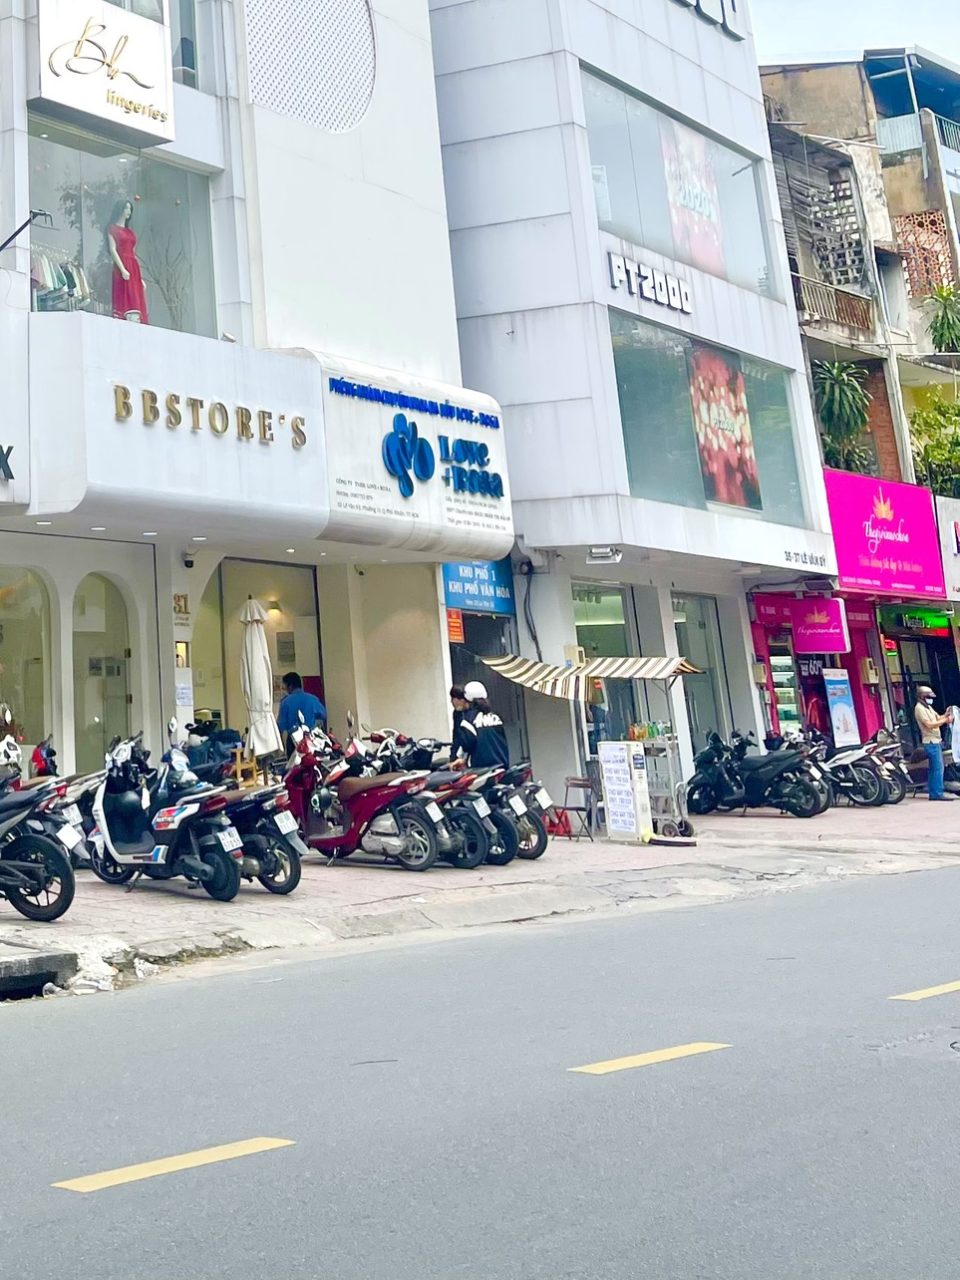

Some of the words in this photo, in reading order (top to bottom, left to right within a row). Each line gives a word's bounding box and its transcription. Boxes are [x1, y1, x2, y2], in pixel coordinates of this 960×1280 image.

[106, 88, 169, 123] lingeries
[607, 251, 693, 314] PT2000
[458, 565, 473, 578] KHU
[491, 570, 496, 581] 1
[448, 581, 463, 593] KHU
[173, 594, 190, 614] 31
